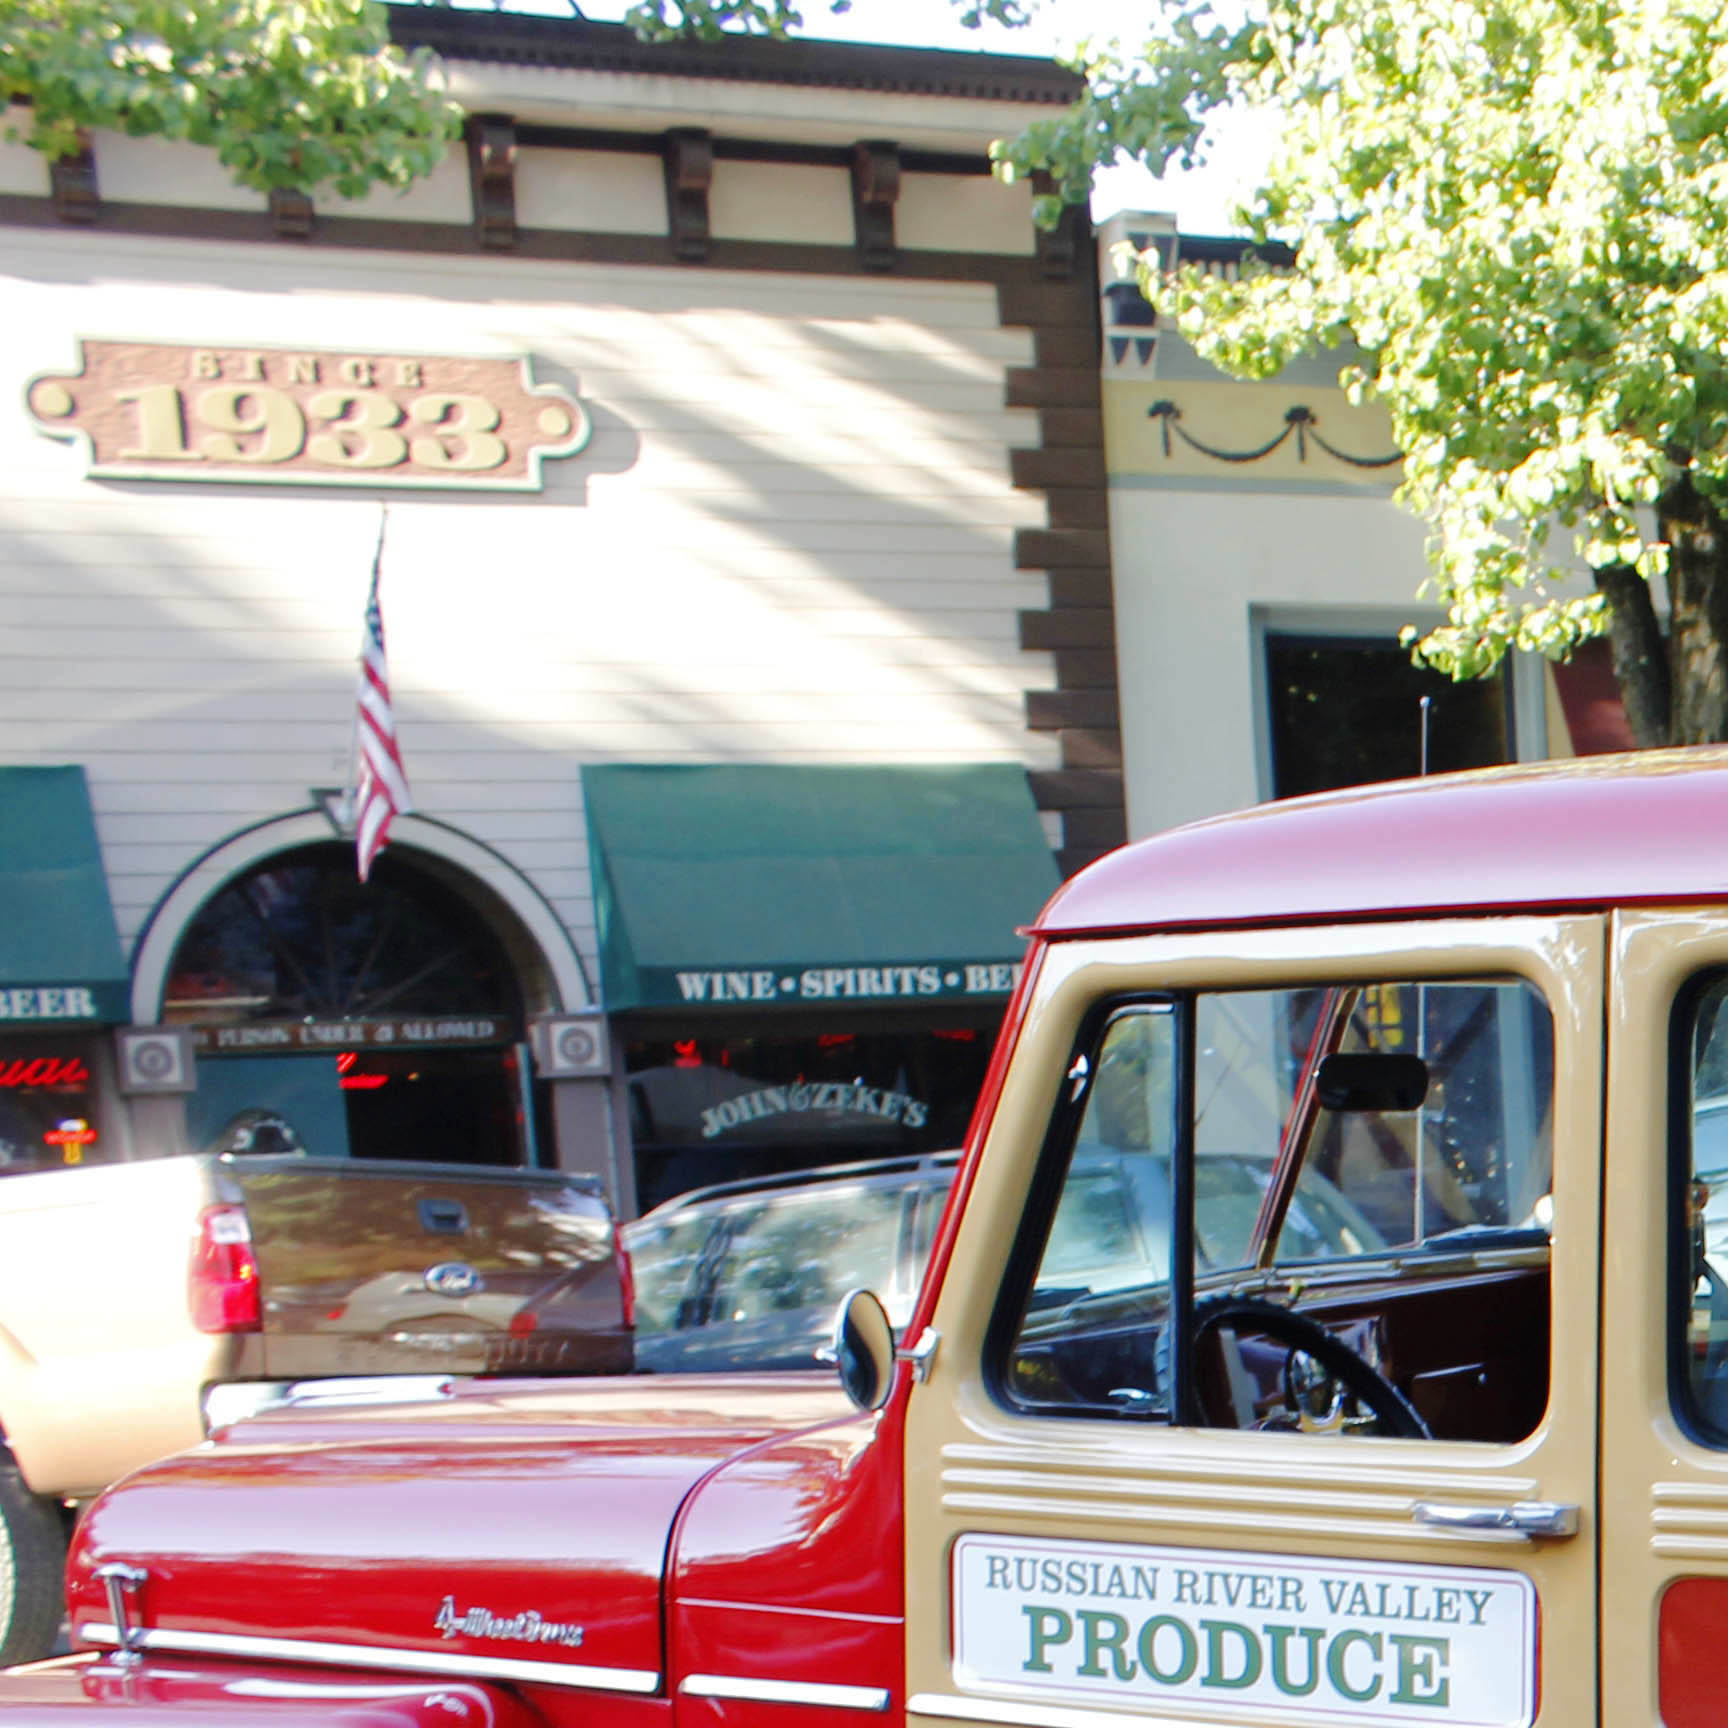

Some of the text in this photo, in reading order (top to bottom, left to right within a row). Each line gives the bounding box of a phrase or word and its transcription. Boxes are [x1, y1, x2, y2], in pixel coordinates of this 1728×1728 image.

[193, 351, 424, 387] SINCE
[114, 382, 507, 470] 1933
[676, 971, 776, 1001] WINE
[799, 965, 942, 998] SPIRITS
[984, 1554, 1496, 1626] RUSSIAN RIVER VALLEY
[1019, 1603, 1453, 1708] PRODUCE
